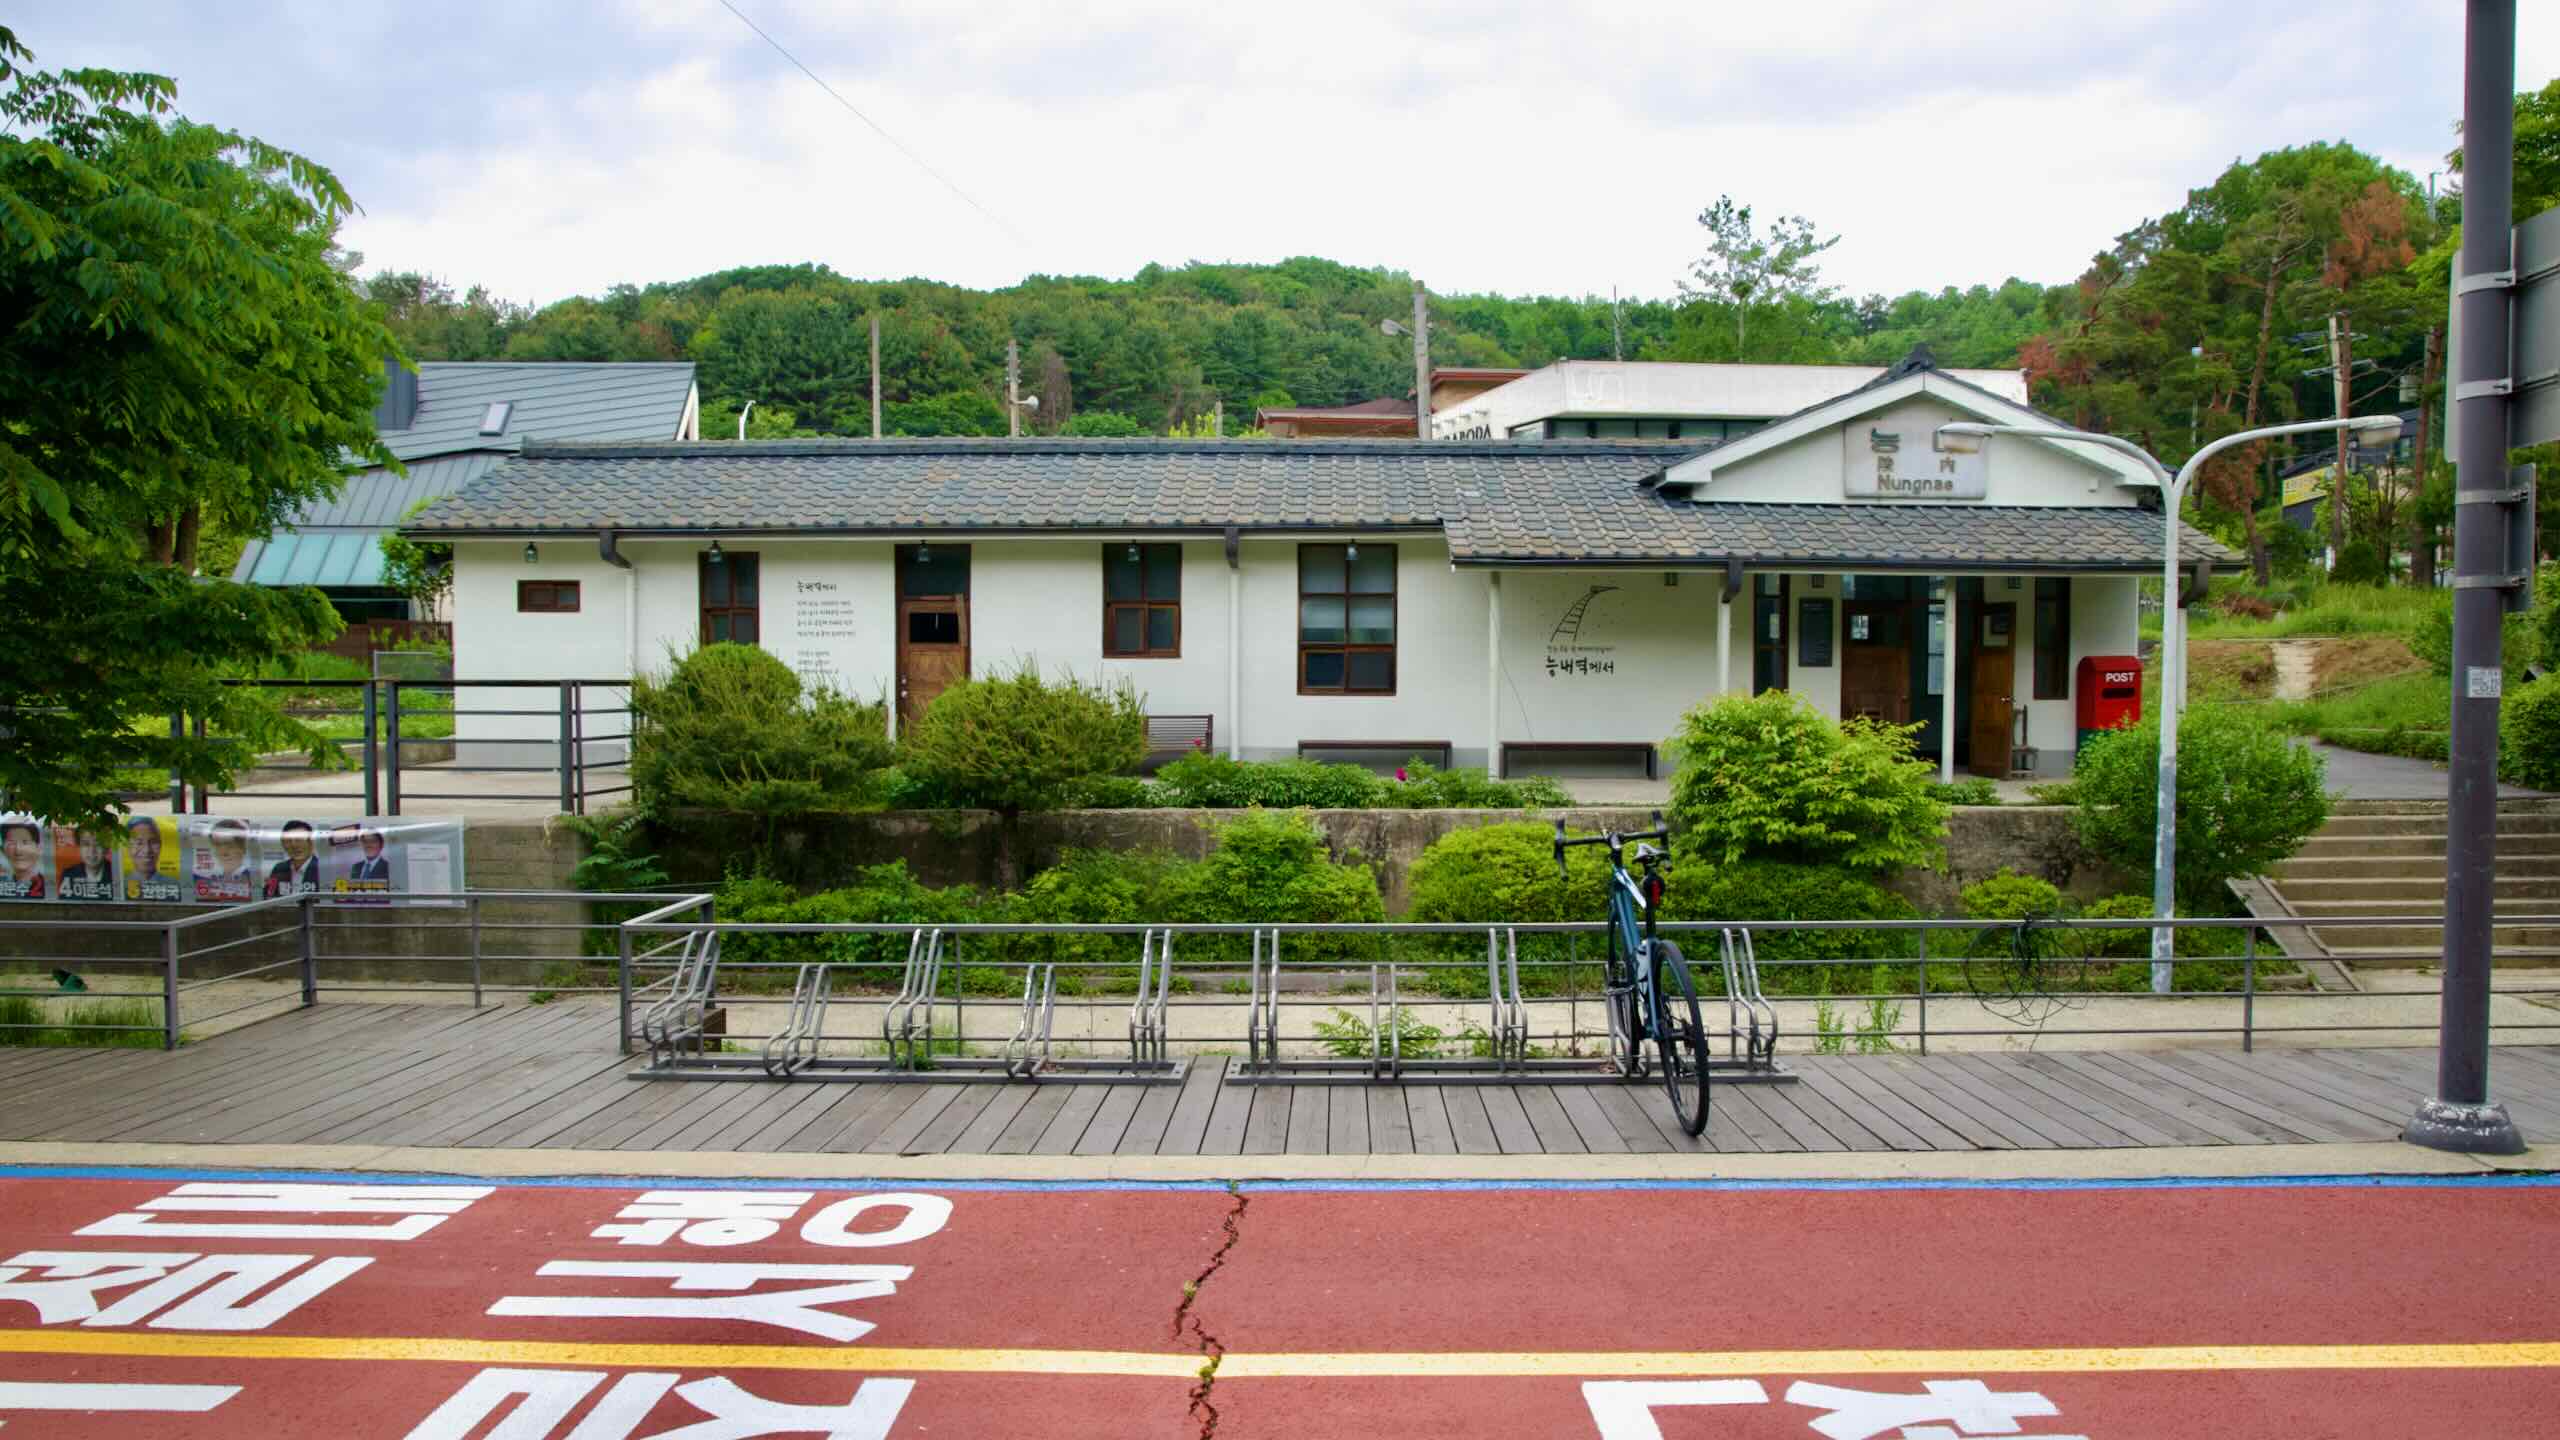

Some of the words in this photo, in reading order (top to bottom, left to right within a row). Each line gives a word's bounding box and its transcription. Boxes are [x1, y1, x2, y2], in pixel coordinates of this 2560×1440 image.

[1876, 474, 1954, 495] Nungnae
[1545, 655, 1614, 678] 능내역에서
[2105, 672, 2136, 683] POST
[60, 877, 73, 897] 4
